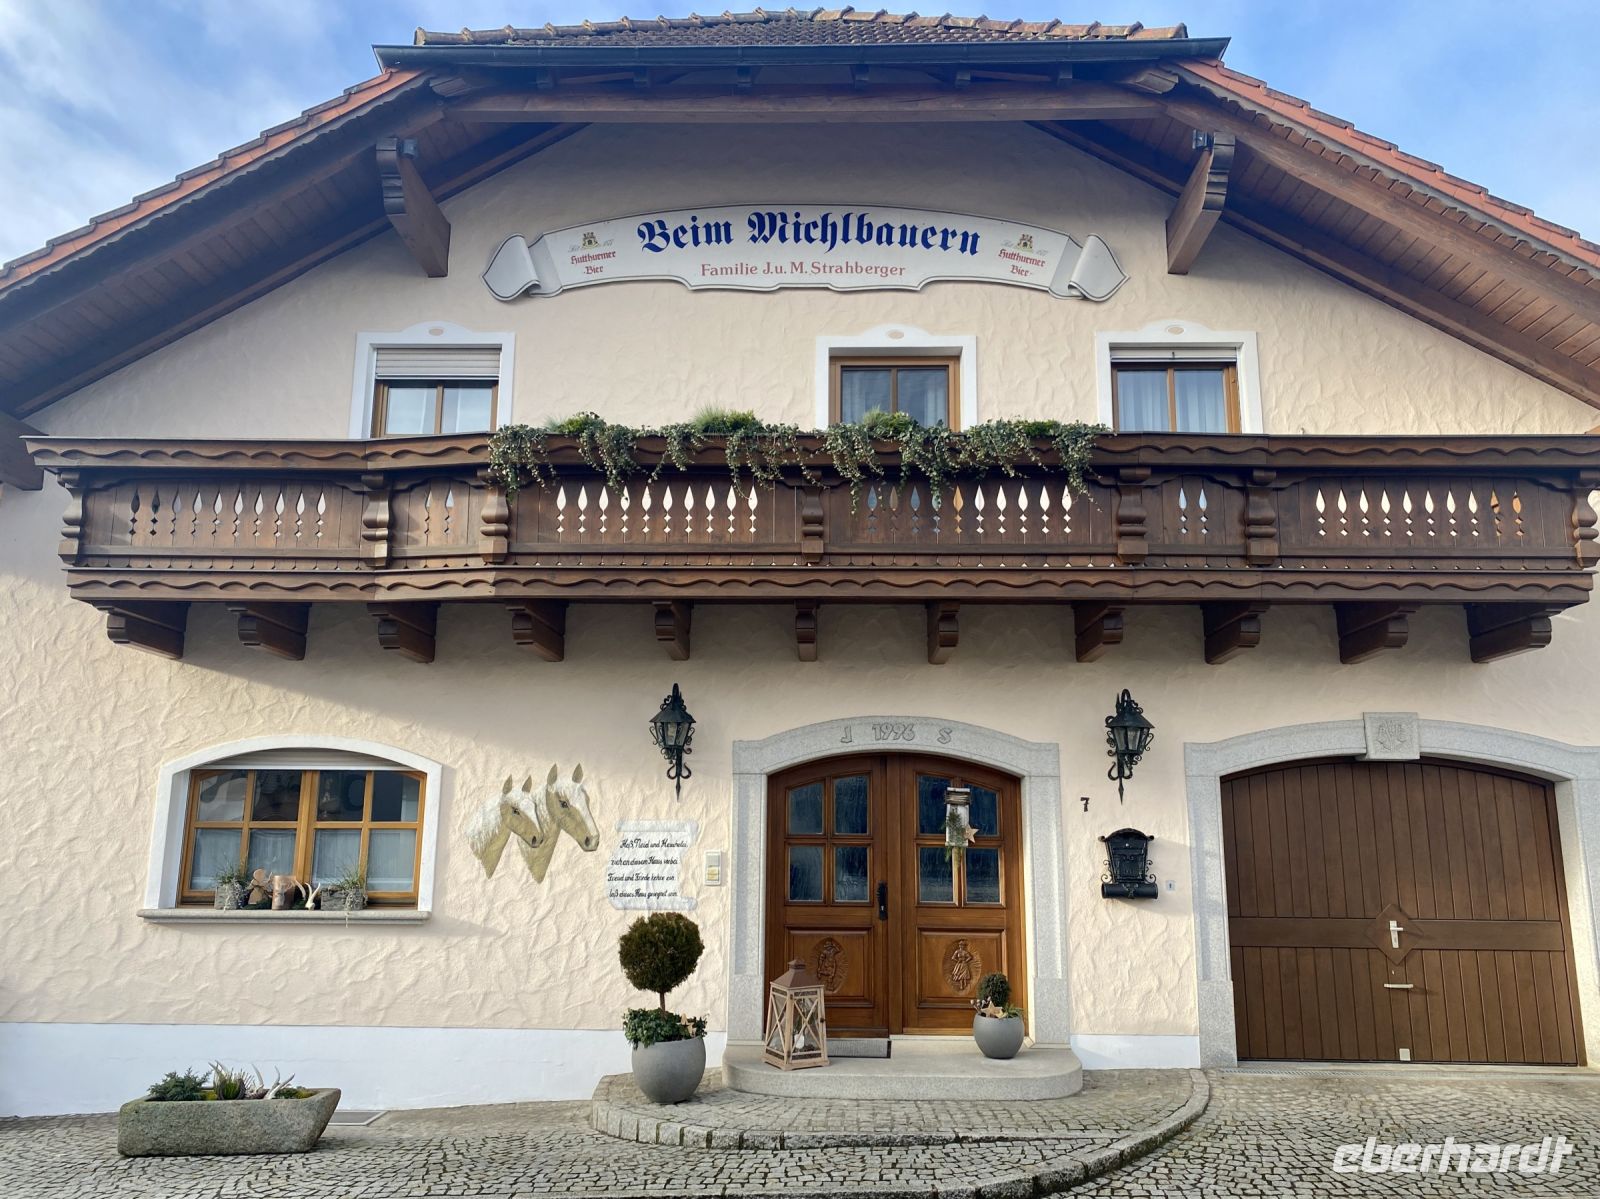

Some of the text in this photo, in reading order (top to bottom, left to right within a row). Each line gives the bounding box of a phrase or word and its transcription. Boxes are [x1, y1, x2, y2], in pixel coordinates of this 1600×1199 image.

[637, 211, 981, 256] Beim Michlbauern
[701, 263, 758, 277] Familie
[1080, 797, 1090, 812] 7
